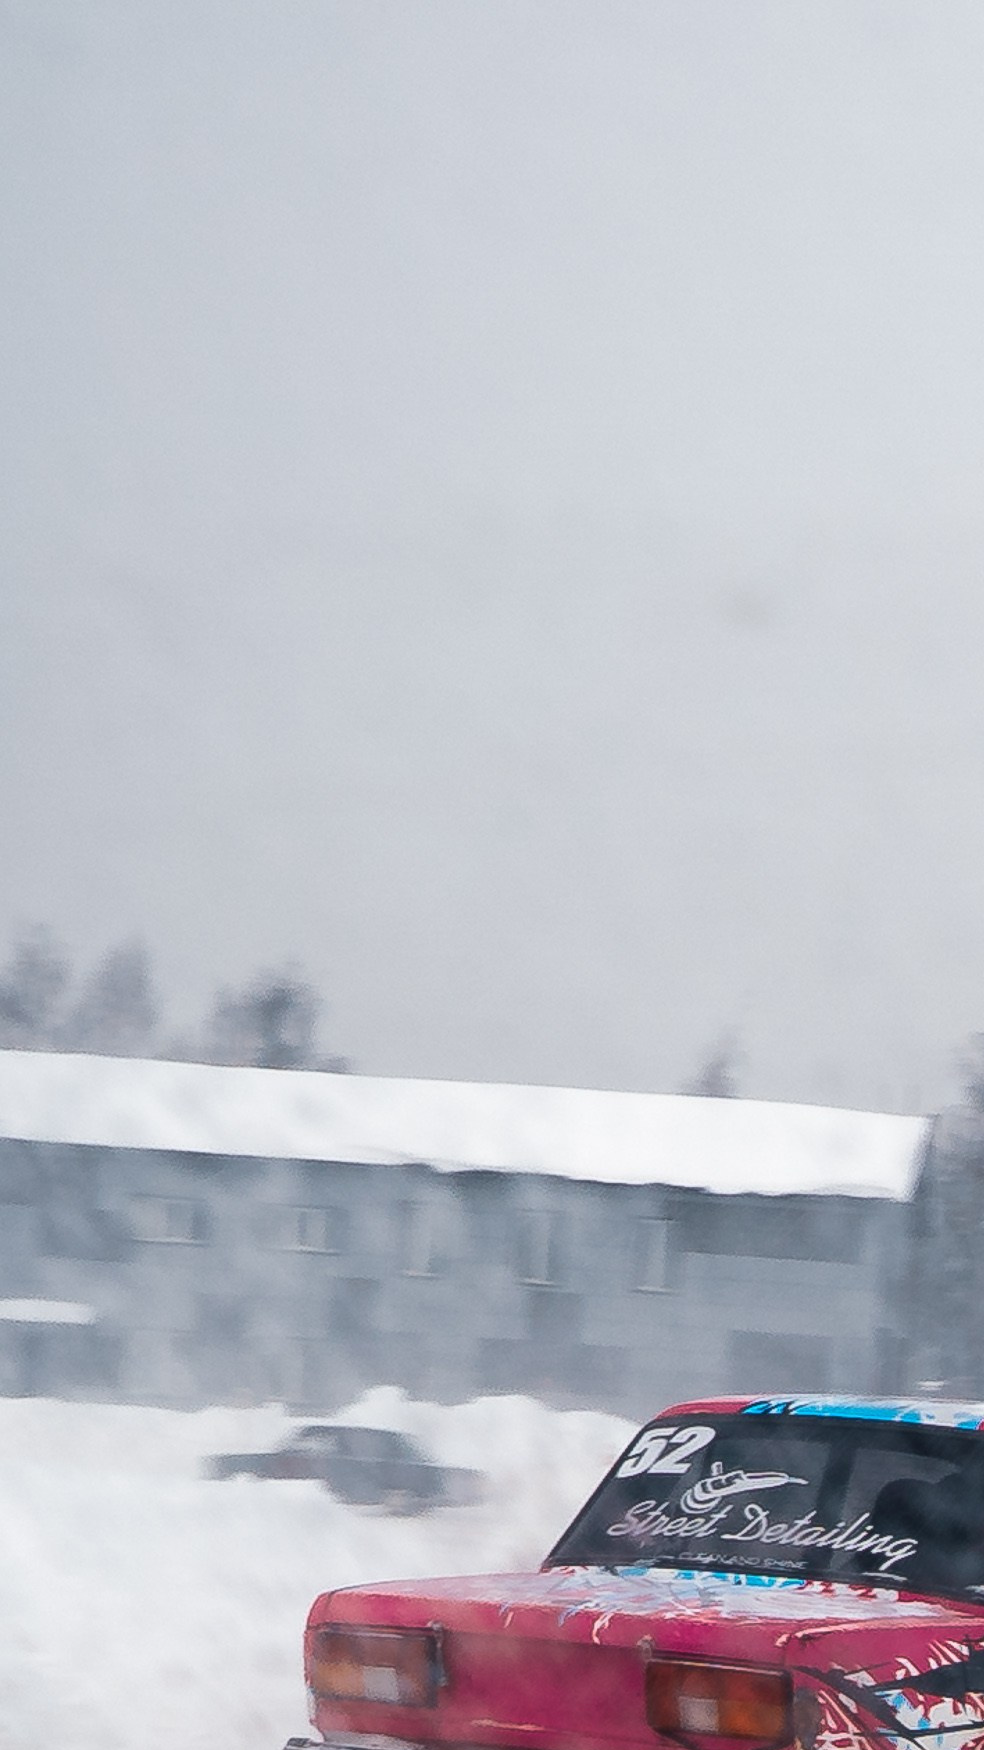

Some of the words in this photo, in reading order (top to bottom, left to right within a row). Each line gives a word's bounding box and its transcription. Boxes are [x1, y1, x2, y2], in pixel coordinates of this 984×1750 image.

[616, 1427, 716, 1478] 52
[607, 1500, 734, 1538] Street
[721, 1504, 918, 1571] Detailing
